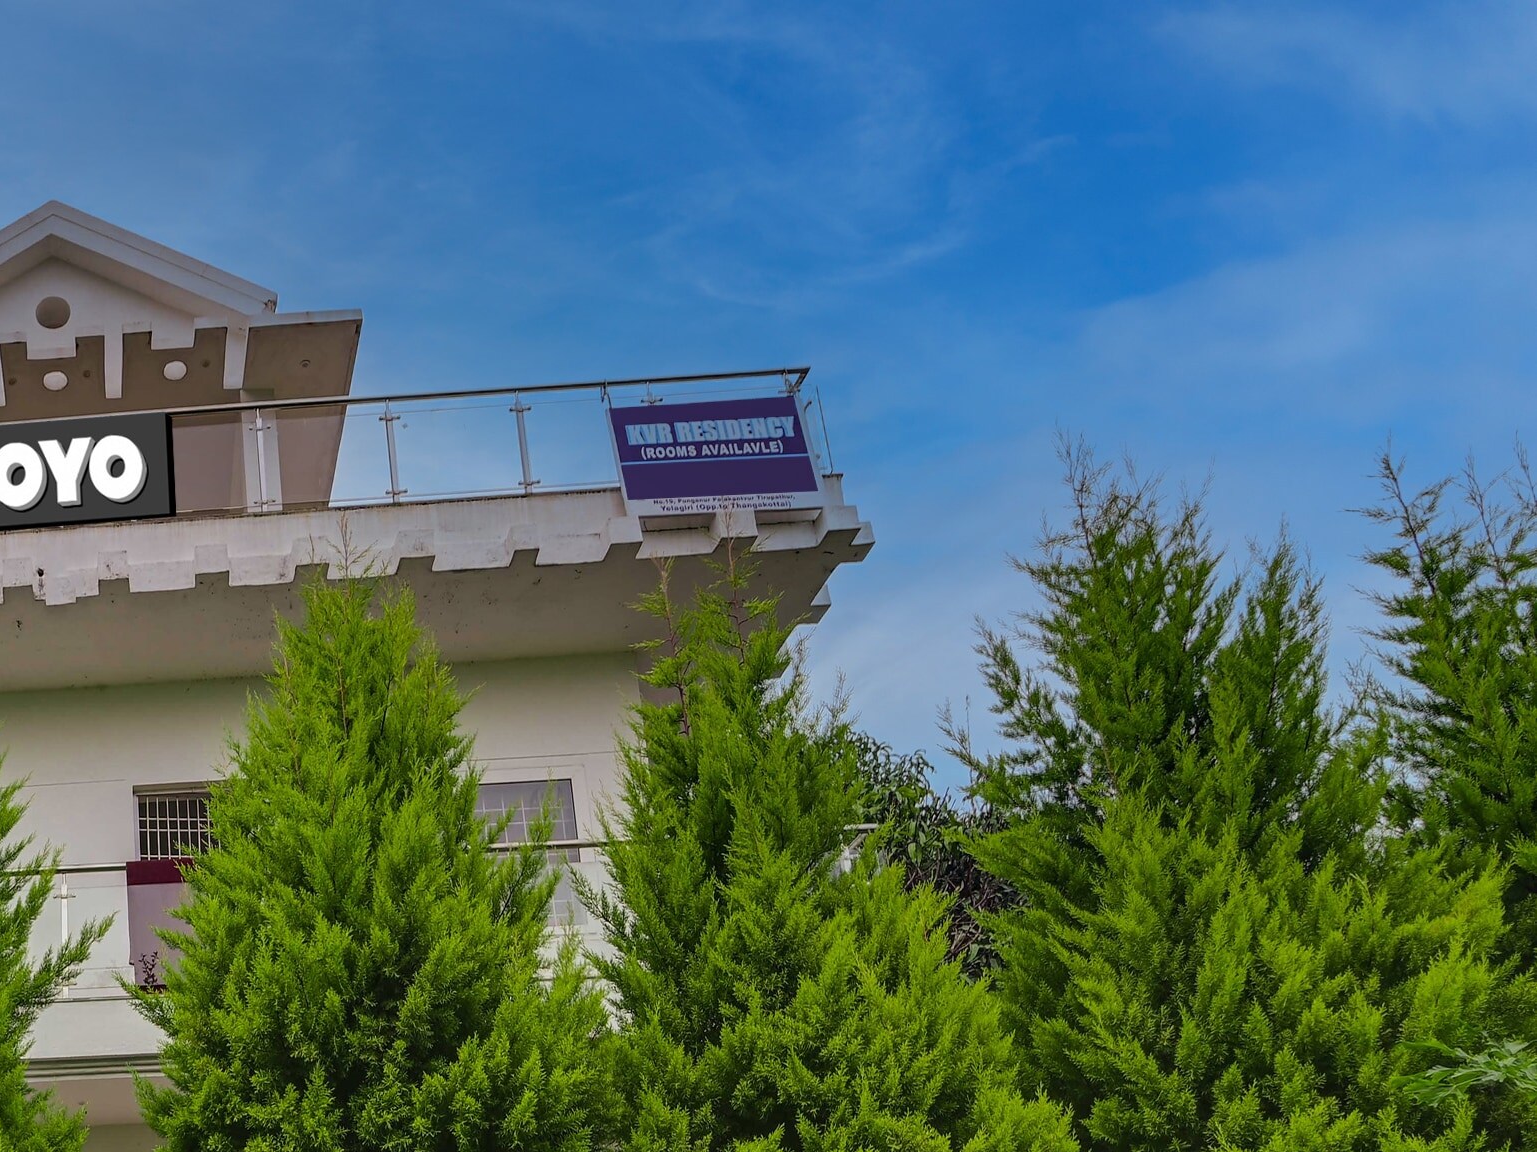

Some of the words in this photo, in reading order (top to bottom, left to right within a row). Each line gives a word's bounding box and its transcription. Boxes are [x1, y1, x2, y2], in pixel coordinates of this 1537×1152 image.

[625, 423, 673, 445] KVR
[674, 416, 795, 443] RESIDENCY
[641, 446, 697, 460] (ROOMS
[701, 440, 784, 456] AVAILAVLE)
